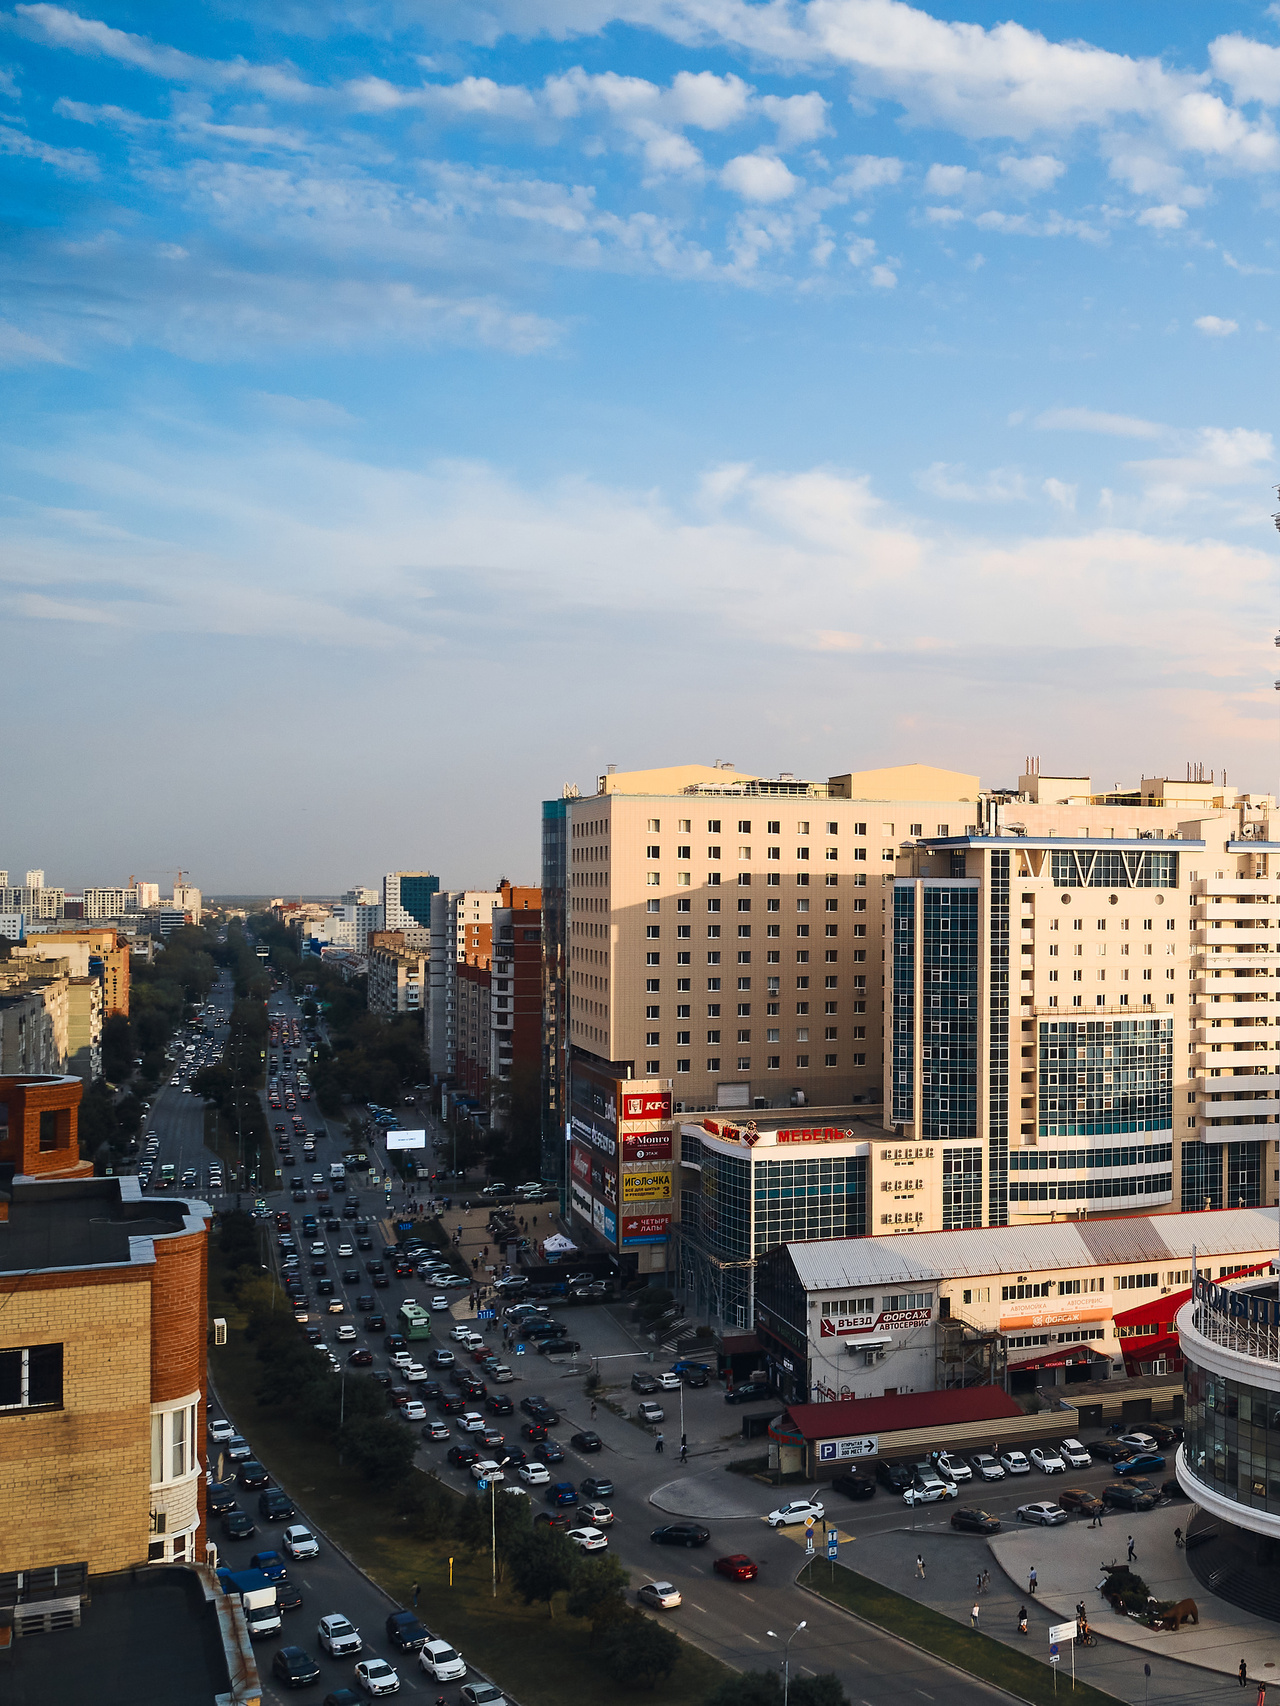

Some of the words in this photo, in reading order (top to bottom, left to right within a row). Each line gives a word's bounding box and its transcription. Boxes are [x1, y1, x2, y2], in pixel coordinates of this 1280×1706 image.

[645, 1101, 669, 1110] KFC
[637, 1135, 670, 1144] Monro
[778, 1128, 845, 1143] МЕБЕЛЬ
[662, 1186, 670, 1195] 3
[641, 1217, 669, 1225] ЧЕТЫРЕ
[1067, 1297, 1103, 1306] АВТОСЕРВИС
[1010, 1303, 1047, 1312] АВТОМОЙКА
[883, 1310, 929, 1322] ФОРСАЖ
[1045, 1313, 1080, 1324] ФОРСАЖ
[838, 1316, 872, 1328] ВЪЕЗД
[879, 1319, 929, 1331] АВТОСЕРВИС
[824, 1446, 833, 1457] P
